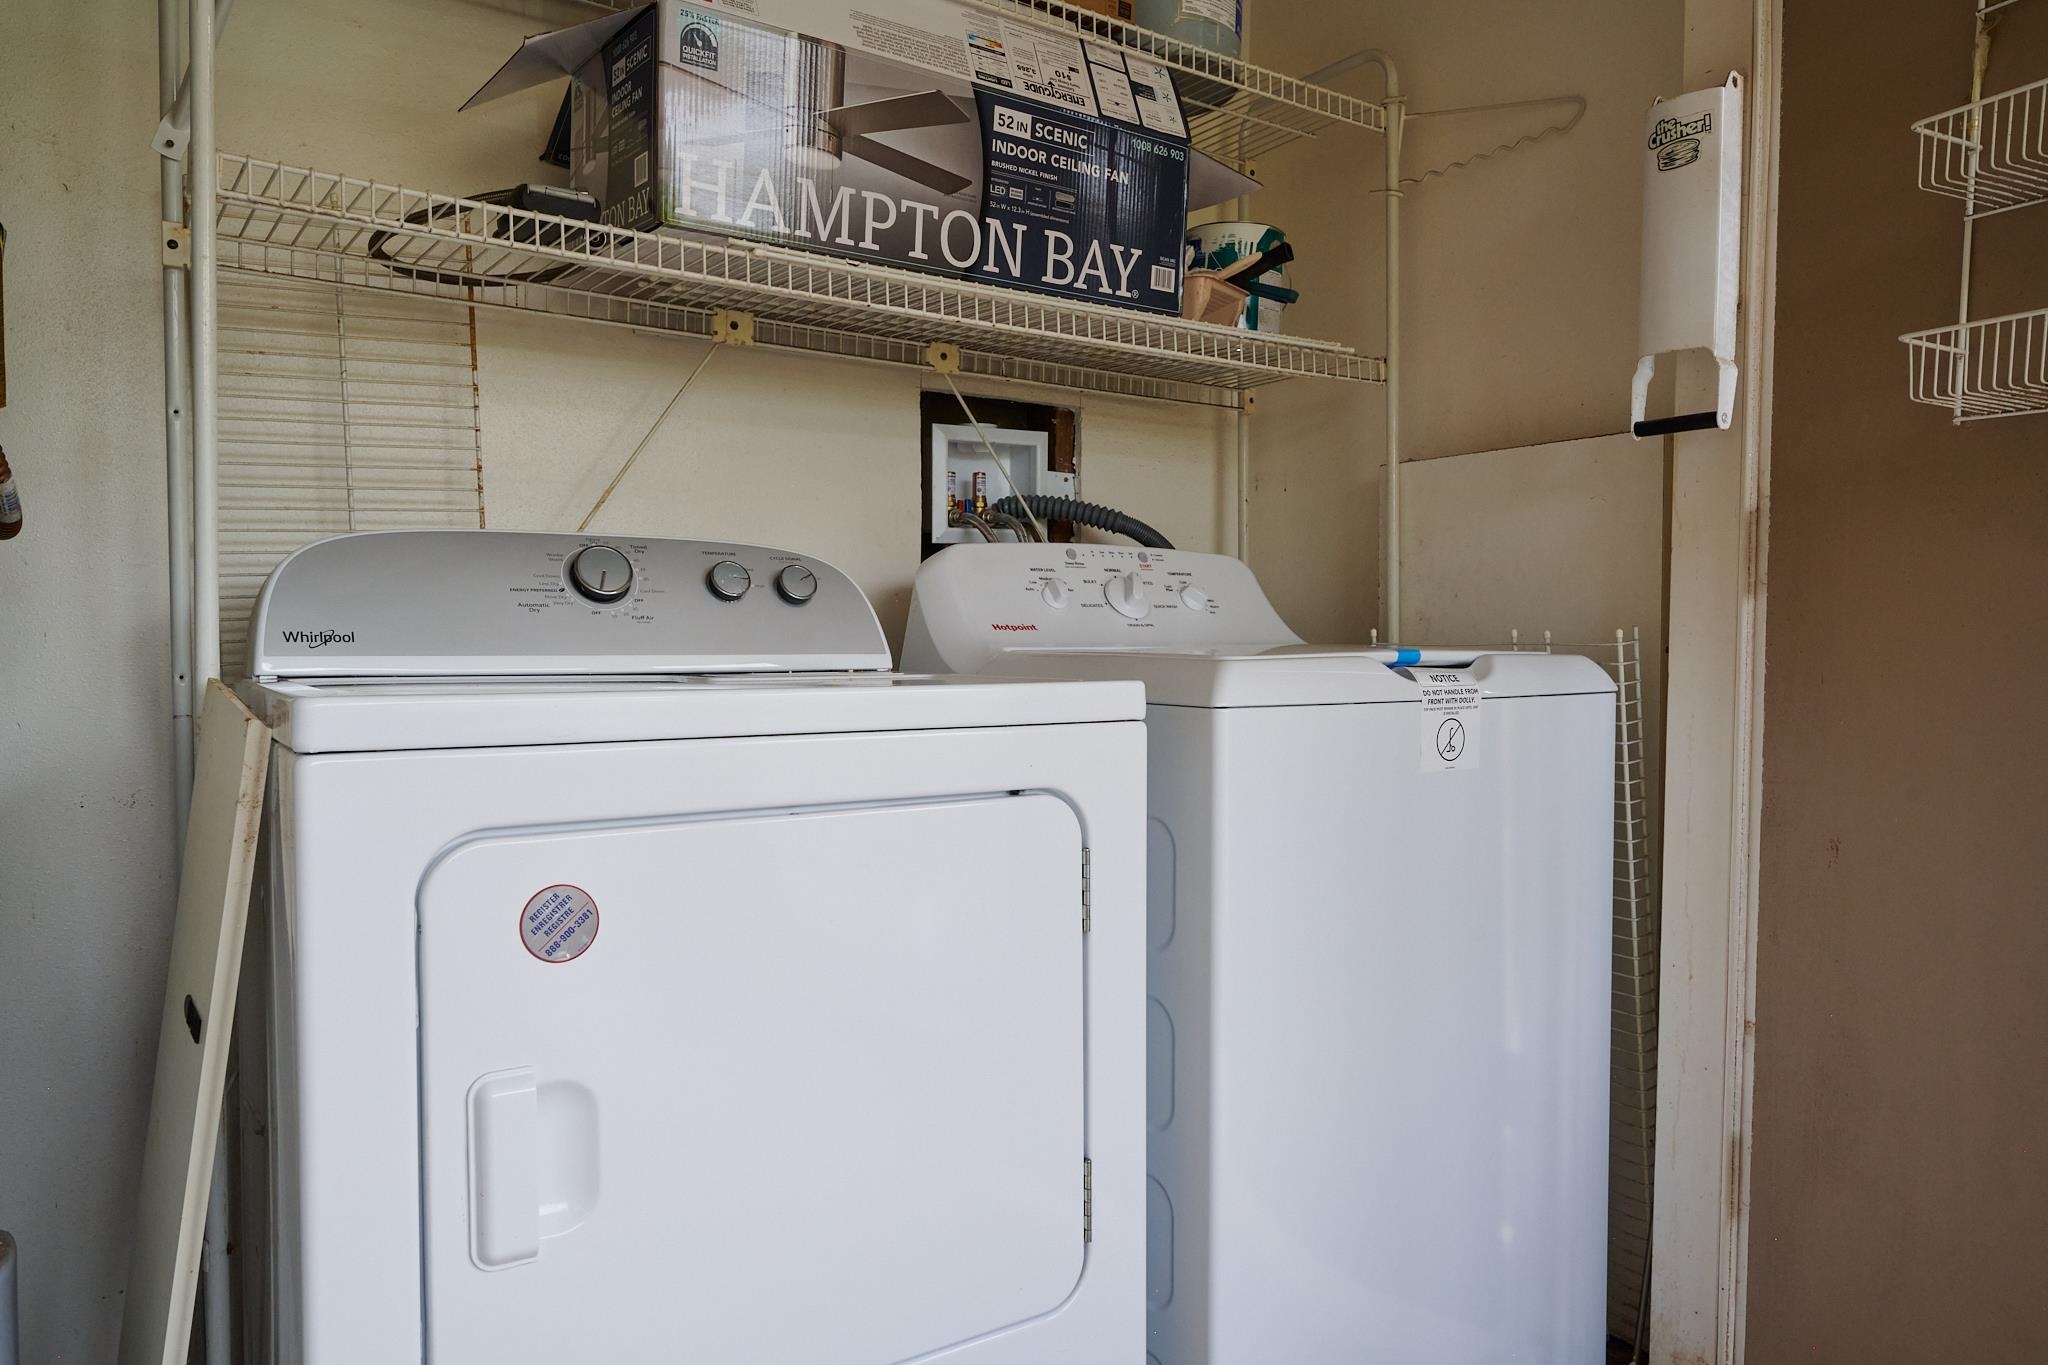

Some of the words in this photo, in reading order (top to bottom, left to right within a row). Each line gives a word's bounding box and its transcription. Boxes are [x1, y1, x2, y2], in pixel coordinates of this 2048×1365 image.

[626, 44, 648, 72] SCENIC
[683, 45, 716, 60] QUICKFIT
[611, 95, 631, 118] CEILING
[631, 86, 643, 104] FAN
[612, 80, 632, 105] INDOOR
[1024, 81, 1086, 107] ENERGYGUIDE
[998, 113, 1014, 131] 52
[1016, 121, 1028, 134] IN
[1035, 123, 1088, 149] SCENIC
[1655, 117, 1678, 135] the
[991, 138, 1047, 165] INDOOR
[1050, 154, 1100, 178] CEILING
[1104, 168, 1129, 185] FAN
[1132, 138, 1152, 152] 1008
[1153, 144, 1169, 157] 626
[1170, 149, 1185, 162] 903
[991, 160, 1018, 172] BRUSHED
[1018, 166, 1039, 178] NICKEL
[1039, 171, 1058, 182] FINISH
[989, 183, 1006, 195] LED
[627, 186, 650, 223] BAY
[674, 153, 1027, 278] HAMPTON
[282, 629, 355, 648] Whirlpool
[991, 623, 1039, 632] Hotpoint
[1429, 674, 1460, 683] NOTICE
[1422, 689, 1433, 697] DO
[1427, 697, 1445, 705] FRONT
[1445, 697, 1458, 705] WITH
[529, 892, 560, 923] REGISTER
[530, 894, 573, 936] ENREGISTRER
[543, 906, 575, 937] REGISTRE
[544, 908, 593, 957] 888-900-3381
